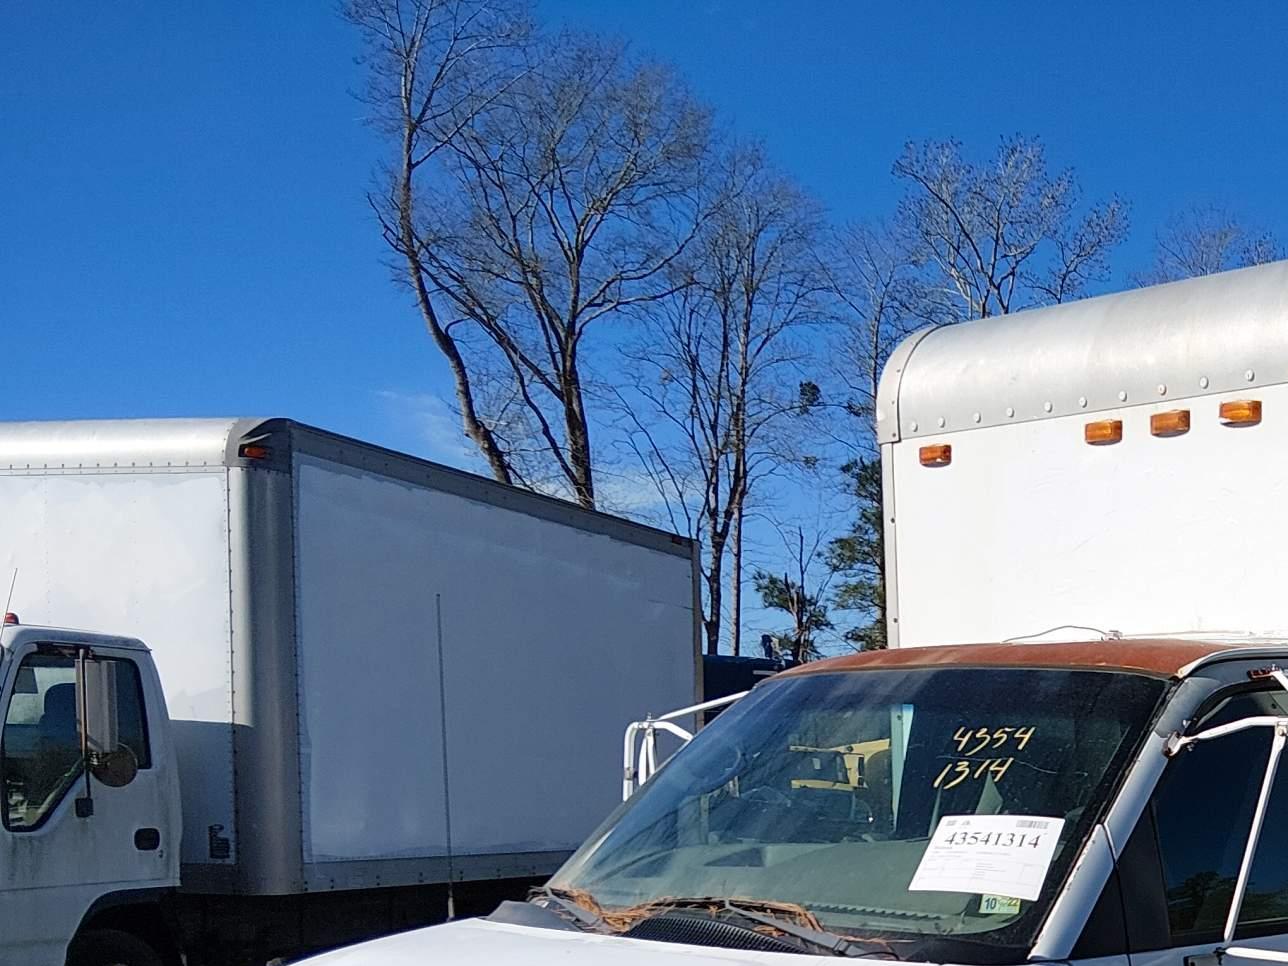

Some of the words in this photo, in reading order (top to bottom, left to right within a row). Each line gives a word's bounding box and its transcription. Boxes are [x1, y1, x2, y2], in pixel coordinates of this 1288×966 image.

[953, 726, 1036, 756] 4354
[933, 757, 1014, 790] 1314
[944, 831, 1041, 849] 43541314
